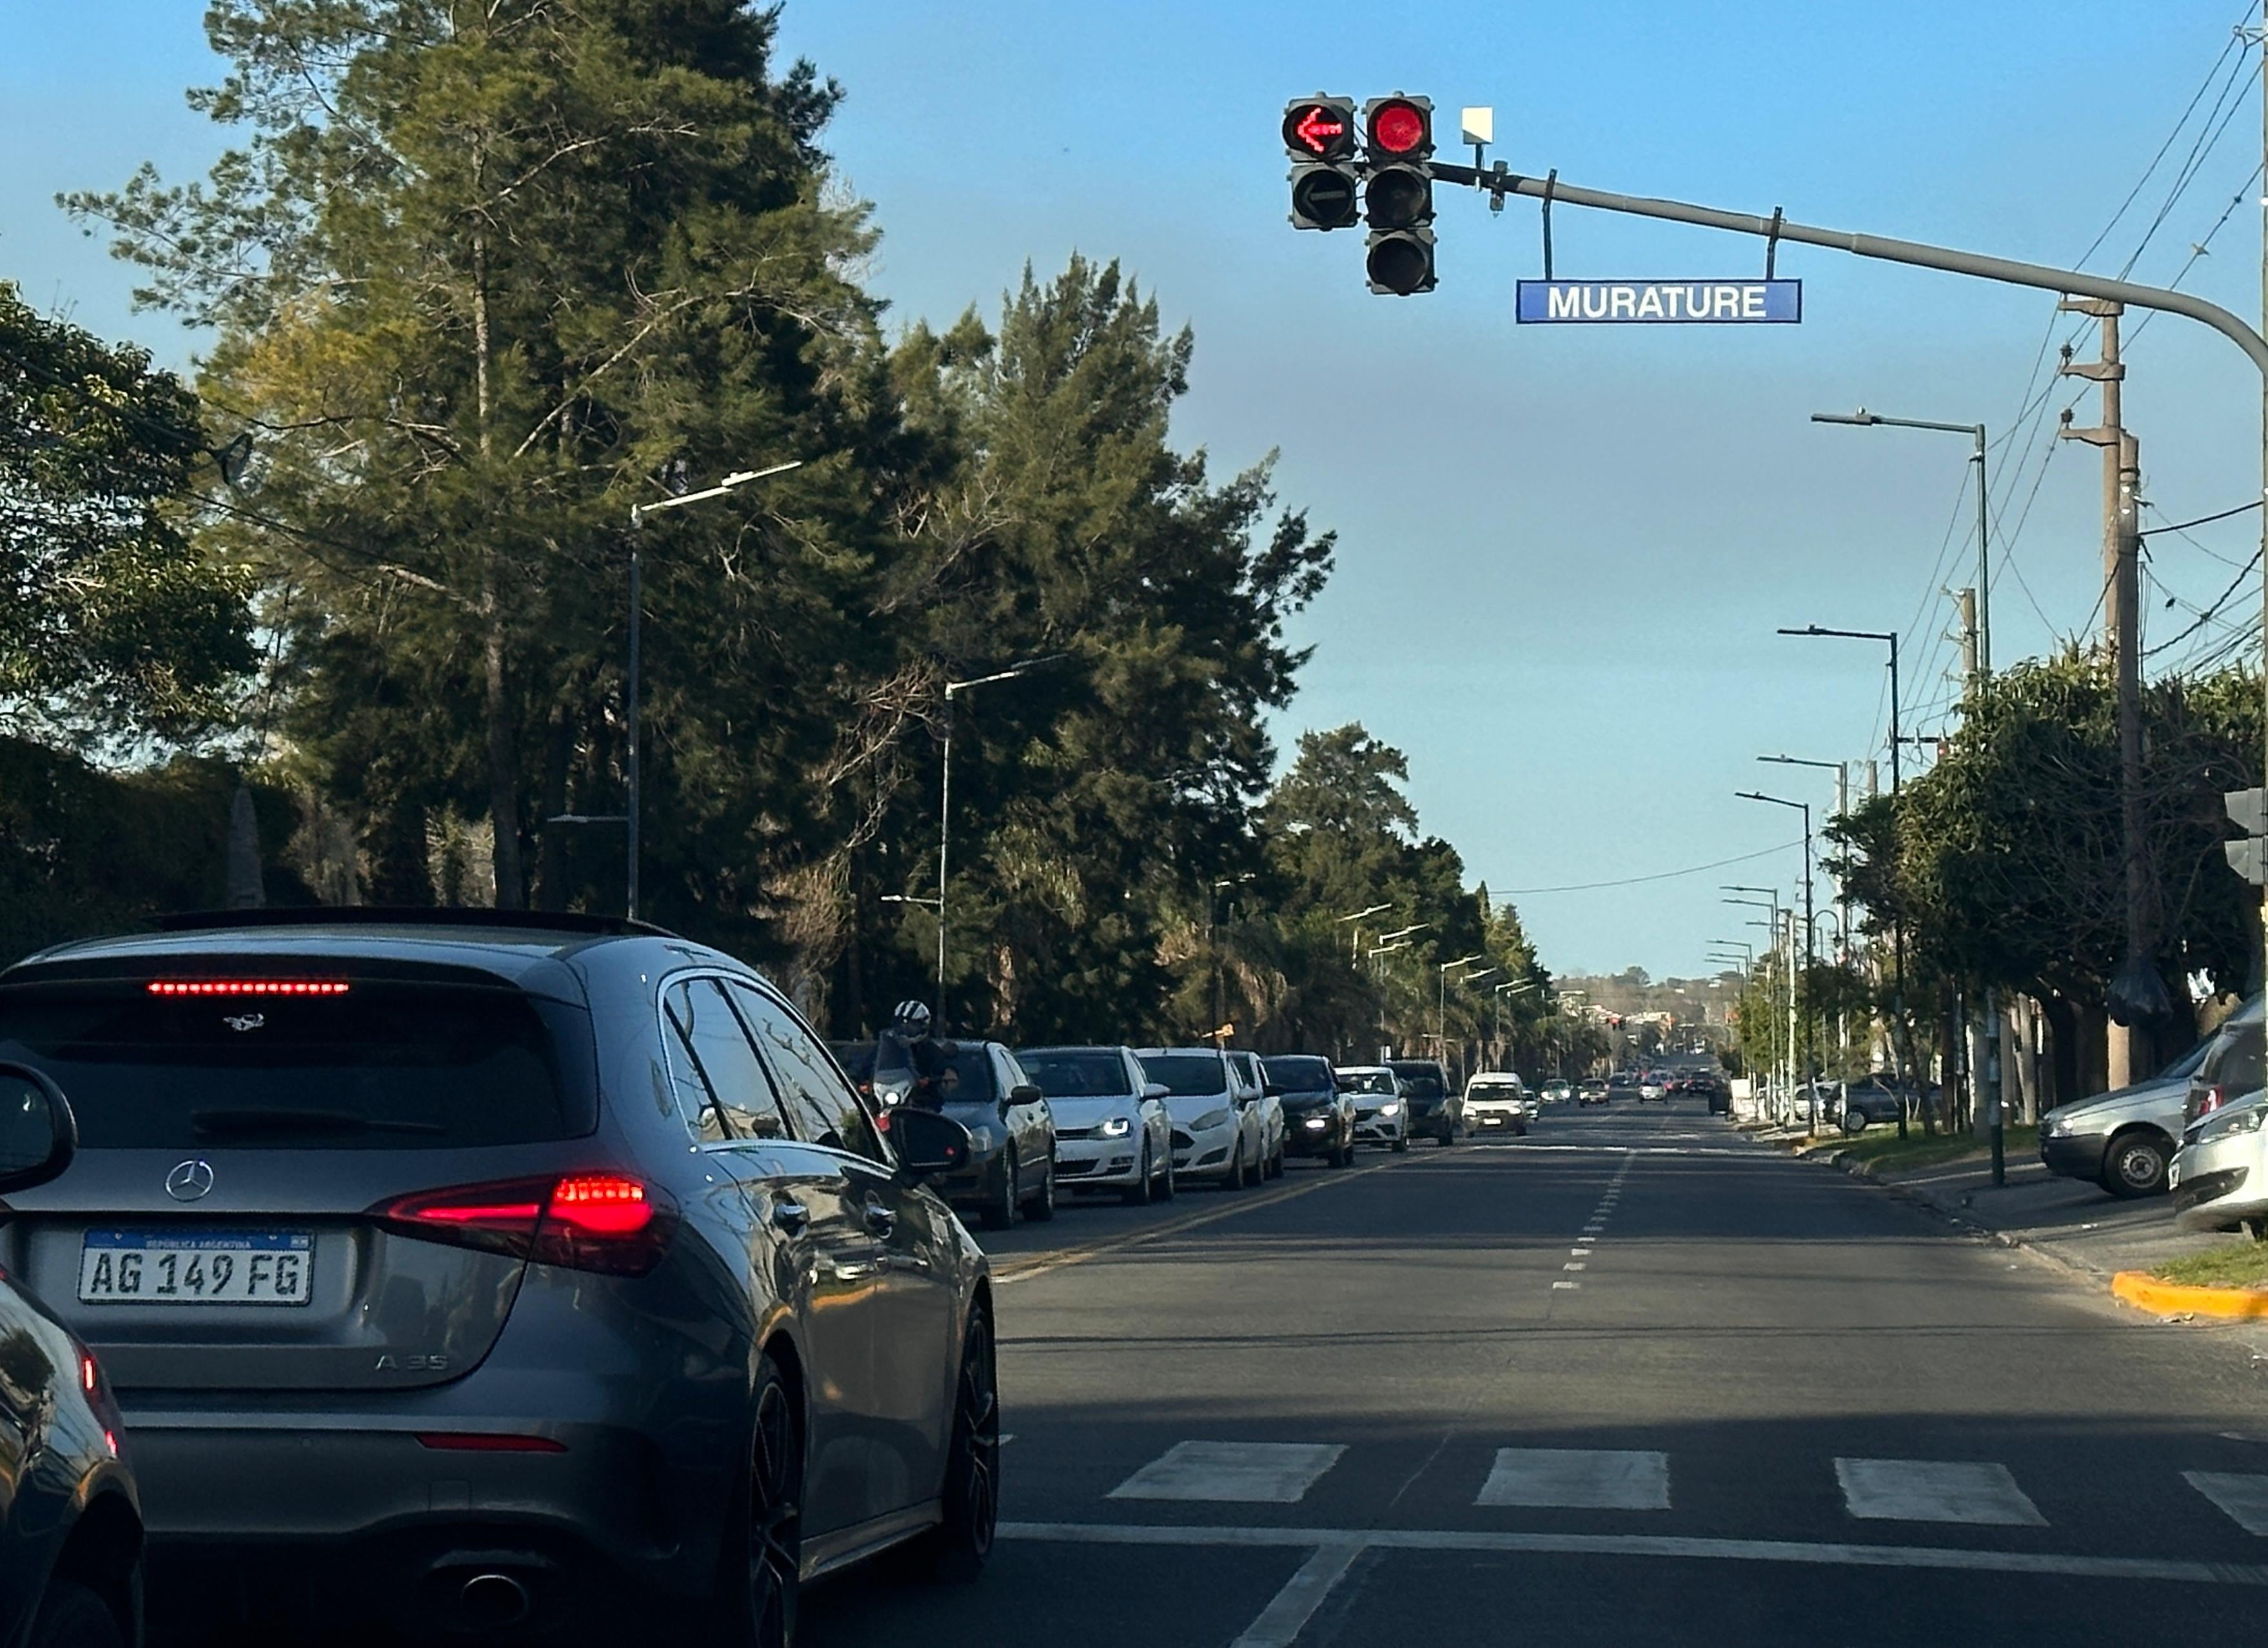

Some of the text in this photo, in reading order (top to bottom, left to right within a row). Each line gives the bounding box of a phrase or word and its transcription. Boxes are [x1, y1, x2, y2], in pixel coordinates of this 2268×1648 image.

[1548, 286, 1767, 318] MURATURE
[198, 1240, 252, 1250] ARGENTINA
[90, 1253, 299, 1295] AG 149 FG
[375, 1355, 398, 1369] A
